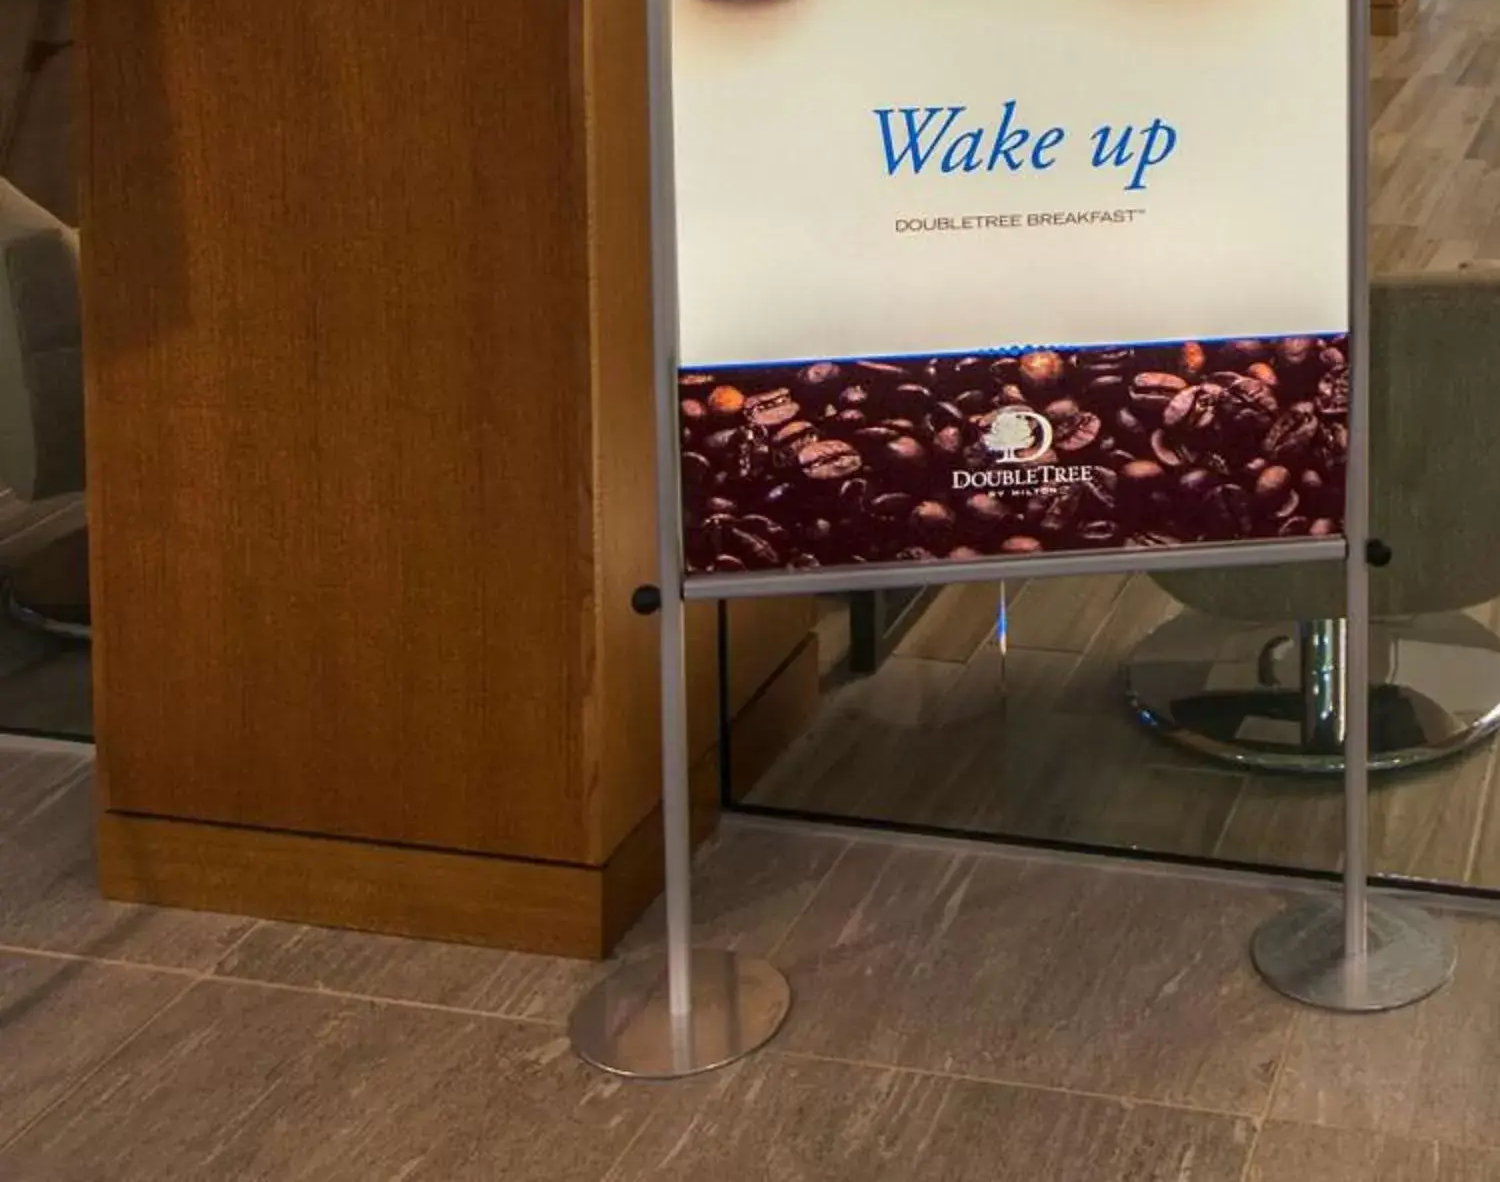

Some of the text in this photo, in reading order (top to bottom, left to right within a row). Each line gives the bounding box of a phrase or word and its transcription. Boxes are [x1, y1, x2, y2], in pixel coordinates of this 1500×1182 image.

[873, 99, 1178, 191] Wake up
[895, 214, 1023, 233] DOUBLETREE
